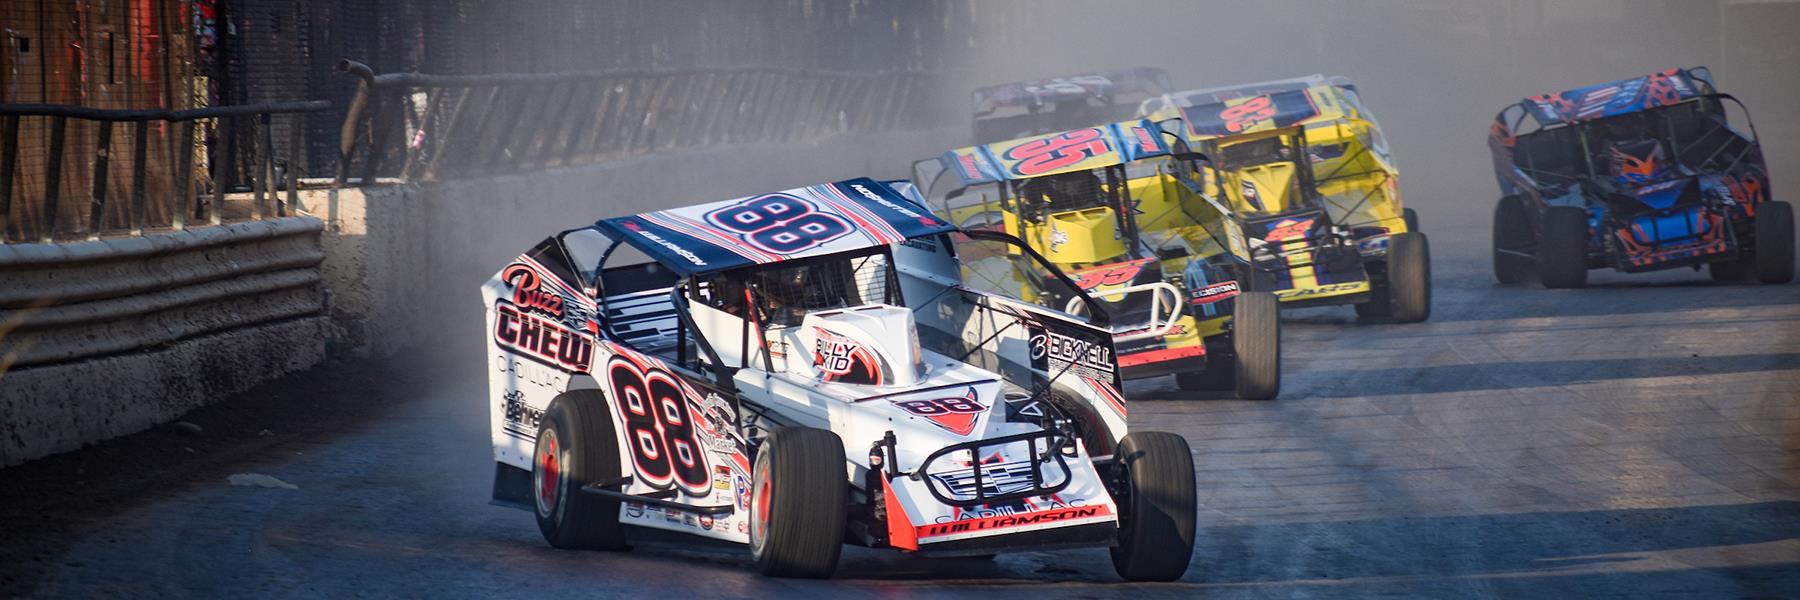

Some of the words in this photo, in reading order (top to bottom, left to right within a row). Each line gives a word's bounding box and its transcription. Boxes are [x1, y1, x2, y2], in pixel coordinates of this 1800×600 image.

[1219, 96, 1278, 133] 83
[1002, 127, 1111, 176] 35
[708, 194, 854, 254] 88
[501, 264, 566, 320] Buzz
[496, 304, 592, 371] CHEW
[816, 338, 857, 357] BILLY
[824, 355, 850, 371] KID
[892, 397, 988, 417] 88
[608, 356, 711, 497] 88
[930, 508, 1098, 536] WILLIAMSON
[935, 498, 1086, 526] CADILLAC
